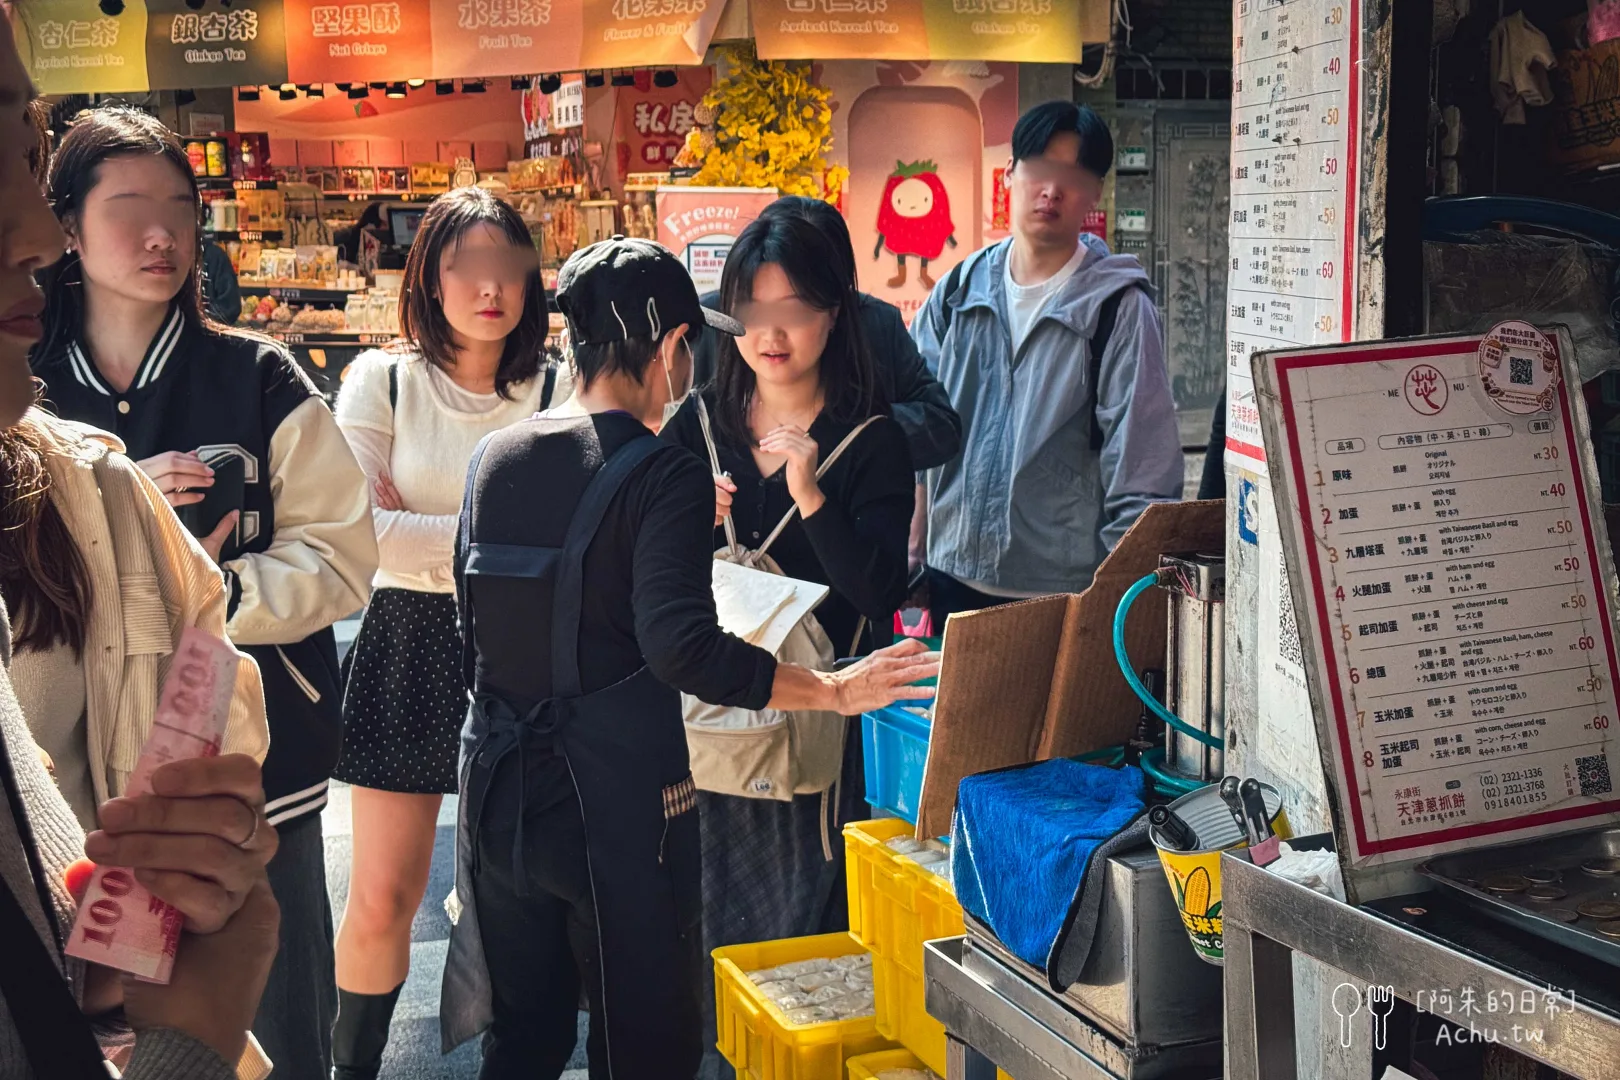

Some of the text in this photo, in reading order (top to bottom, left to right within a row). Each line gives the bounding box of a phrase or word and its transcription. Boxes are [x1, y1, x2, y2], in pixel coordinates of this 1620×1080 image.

[311, 2, 401, 37] 堅果酥
[458, 0, 552, 29] 水果茶
[39, 18, 120, 49] 杏仁茶
[171, 9, 258, 44] 銀杏茶
[874, 20, 899, 33] Tea
[329, 43, 351, 57] Nut
[479, 34, 533, 50] Fruit Tea
[104, 53, 124, 66] Tea
[224, 47, 246, 61] Tea
[663, 205, 740, 237] Freeze!
[1388, 383, 1465, 398] ME NU
[1337, 441, 1354, 451] 品項
[1425, 450, 1448, 459] Original
[1427, 460, 1456, 469] オリジナル
[1314, 470, 1326, 487] 1
[1332, 469, 1352, 481] 原味
[1431, 488, 1456, 496] with egg
[1321, 507, 1333, 525] 2
[1338, 507, 1359, 520] 加蛋
[1438, 519, 1519, 535] with Taiwanese Basil and egg
[1328, 546, 1339, 563] 3
[1345, 543, 1385, 559] 九層塔蛋
[1445, 560, 1495, 572] with ham and egg
[1335, 585, 1346, 602] 4
[1352, 581, 1392, 598] 火腿加蛋
[1452, 597, 1508, 610] with cheese and egg
[1342, 624, 1352, 641] 5
[1358, 619, 1399, 636] 起司加蛋
[1459, 640, 1472, 648] with
[1473, 637, 1502, 647] Taiwanese
[1533, 630, 1553, 639] cheese
[1460, 647, 1483, 656] and egg
[1349, 667, 1360, 684] 6
[1467, 683, 1518, 695] with corn and egg
[1356, 710, 1366, 728] 7
[1373, 706, 1414, 723] 玉米加蛋
[1475, 725, 1488, 734] with
[1504, 721, 1523, 730] cheese
[1523, 718, 1535, 727] and
[1535, 718, 1547, 726] egg
[1380, 738, 1420, 756] 玉米起司
[1363, 750, 1374, 768] 8
[1382, 755, 1403, 769] 加蛋
[1480, 767, 1543, 787] (02) 2321-1336
[754, 781, 771, 792] Lee
[1394, 786, 1421, 800] 永康街
[1482, 779, 1545, 800] (02) 2321-3768
[1484, 791, 1548, 811] 0918401855
[81, 869, 133, 951] 100
